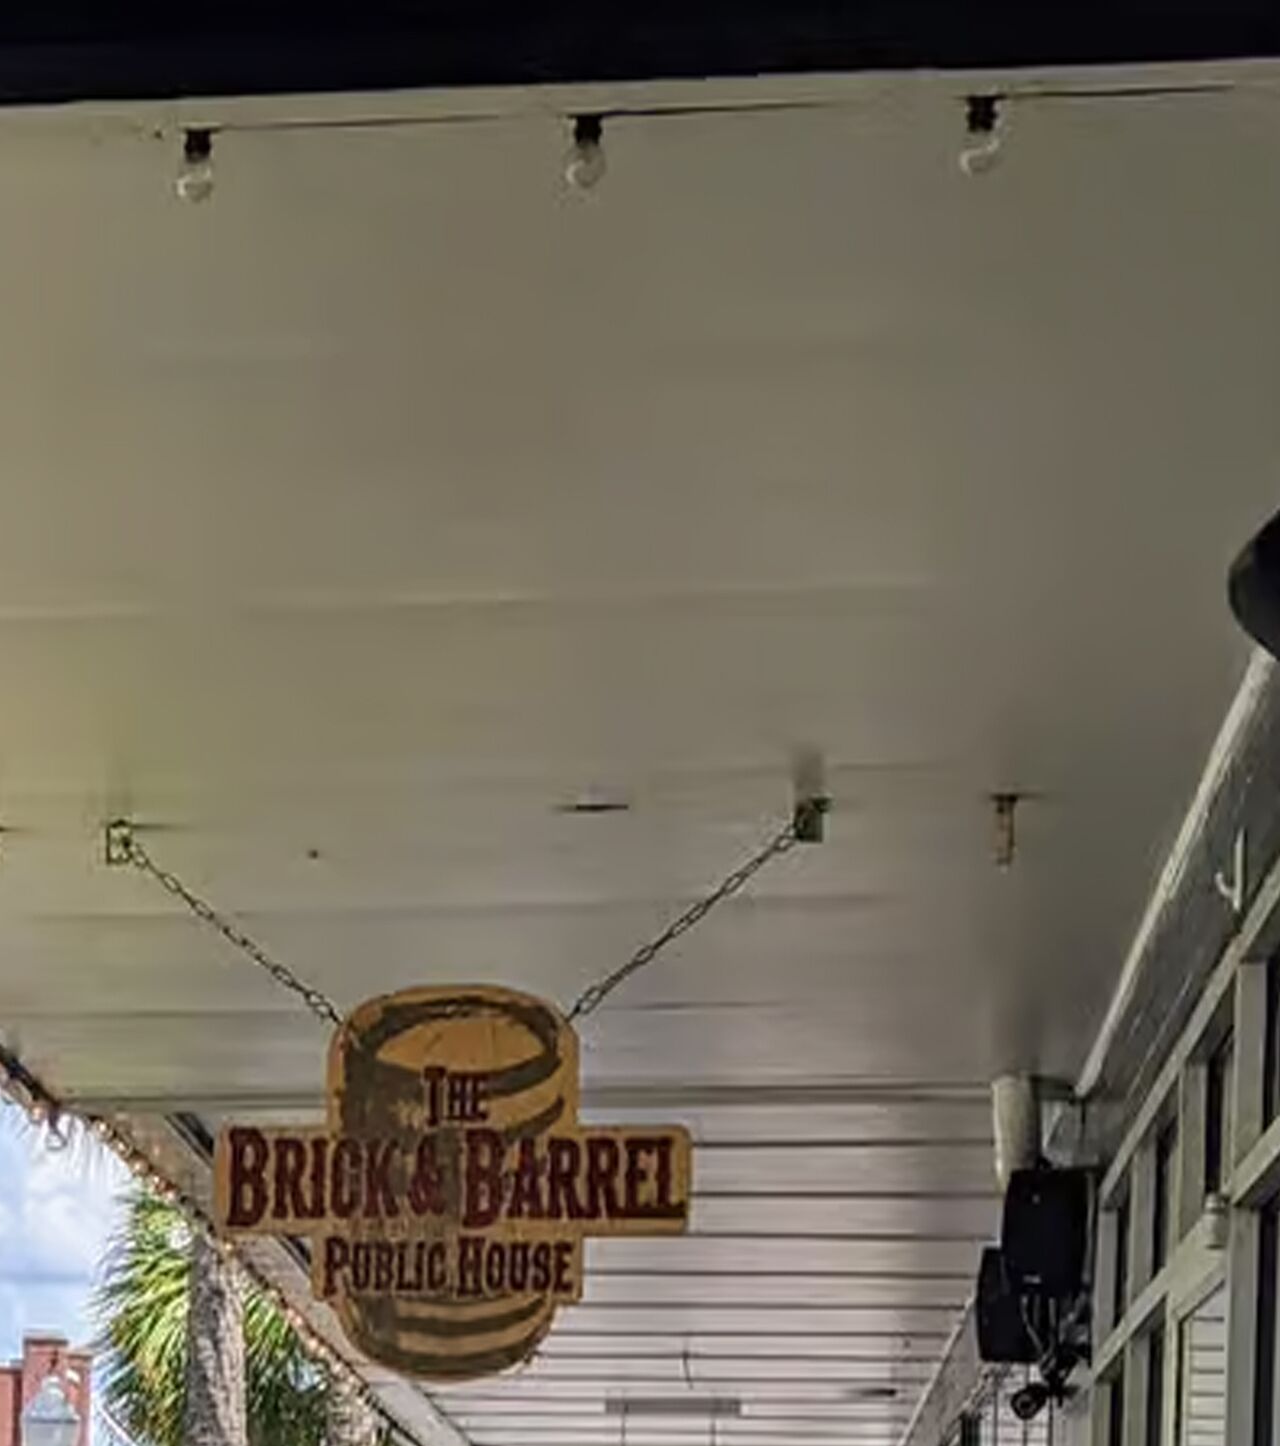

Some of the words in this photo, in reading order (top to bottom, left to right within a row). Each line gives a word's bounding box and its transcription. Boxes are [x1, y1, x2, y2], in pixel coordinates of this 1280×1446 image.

[422, 1066, 489, 1123] THE
[226, 1125, 398, 1227] BRICK
[407, 1138, 448, 1219] &
[462, 1127, 687, 1227] BARREL
[324, 1236, 448, 1296] PUBLIC
[458, 1238, 575, 1296] HOUSE
